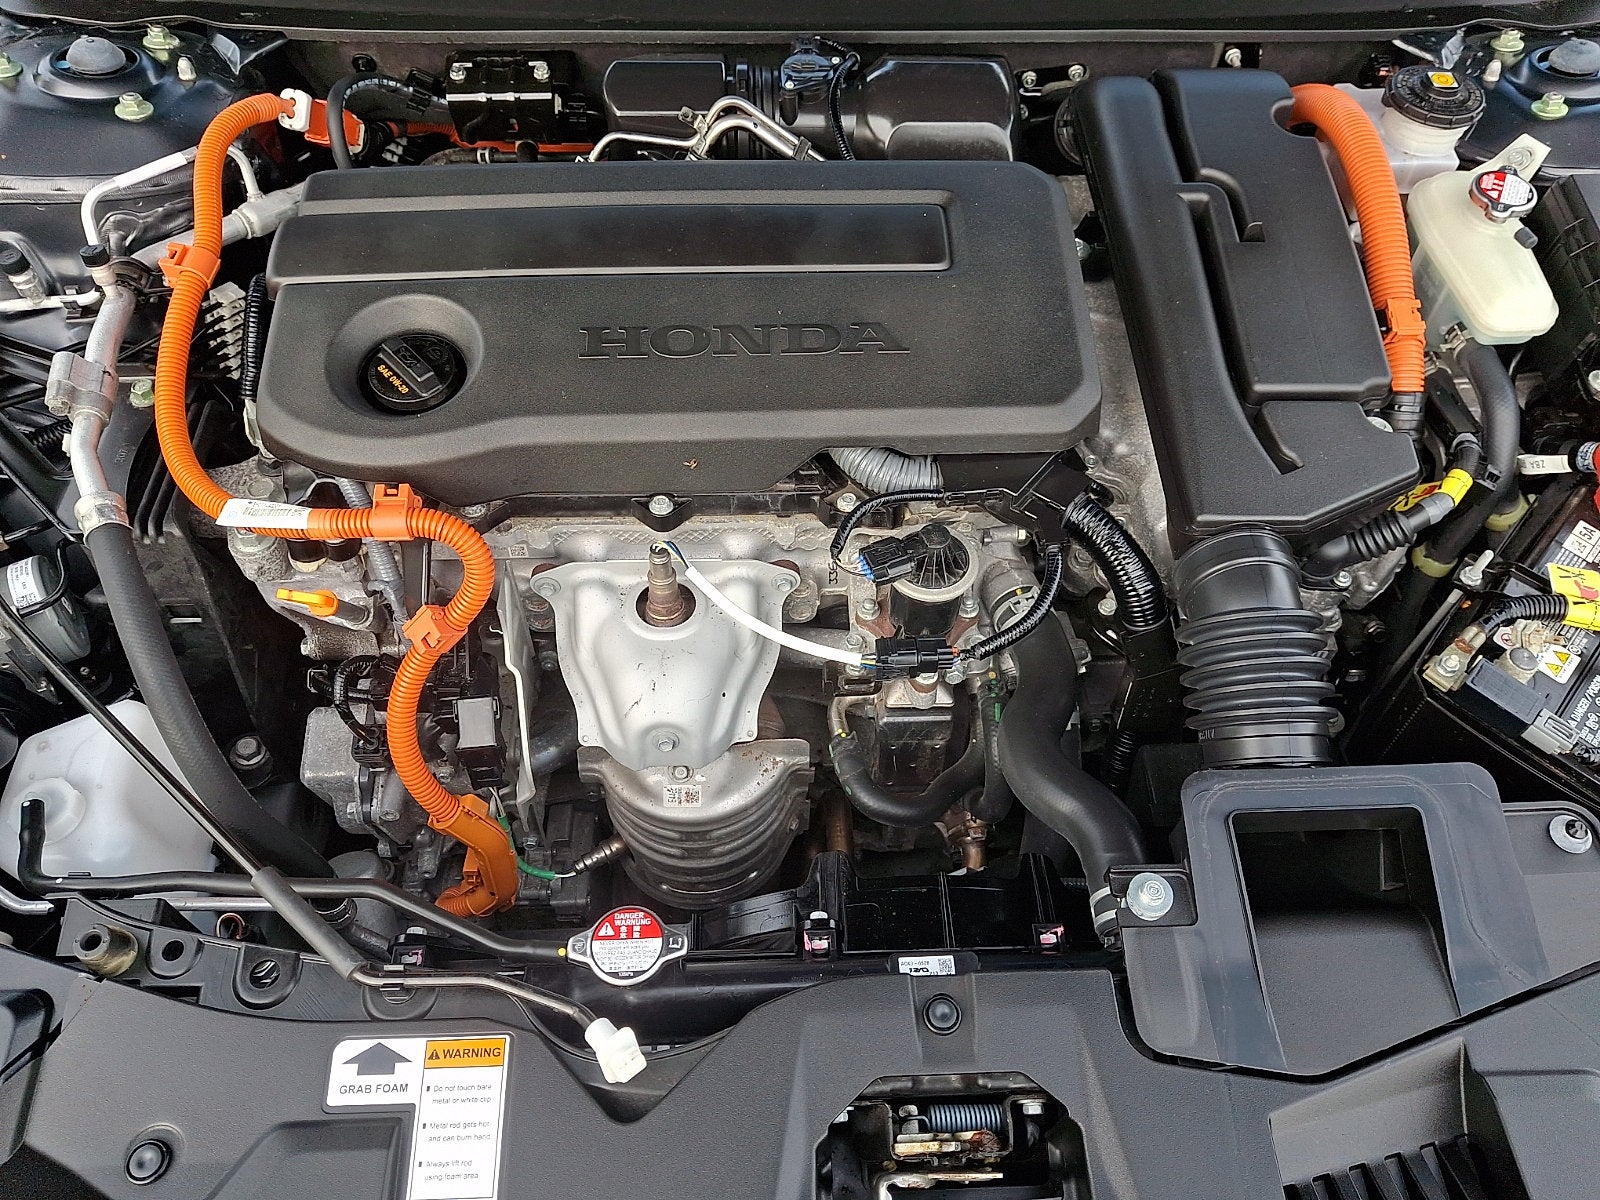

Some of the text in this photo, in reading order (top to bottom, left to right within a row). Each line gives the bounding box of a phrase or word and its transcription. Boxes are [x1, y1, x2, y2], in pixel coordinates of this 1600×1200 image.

[577, 322, 911, 358] HONDA
[377, 364, 393, 378] SAE
[389, 376, 409, 394] 0W-20
[614, 918, 651, 926] WARNUNG
[442, 1047, 501, 1059] WARNING
[339, 1083, 409, 1094] GRAB FOAM
[462, 1121, 477, 1130] gets
[425, 1160, 450, 1169] Always
[460, 1159, 473, 1167] rod
[424, 1173, 443, 1182] using
[463, 1172, 479, 1180] area
